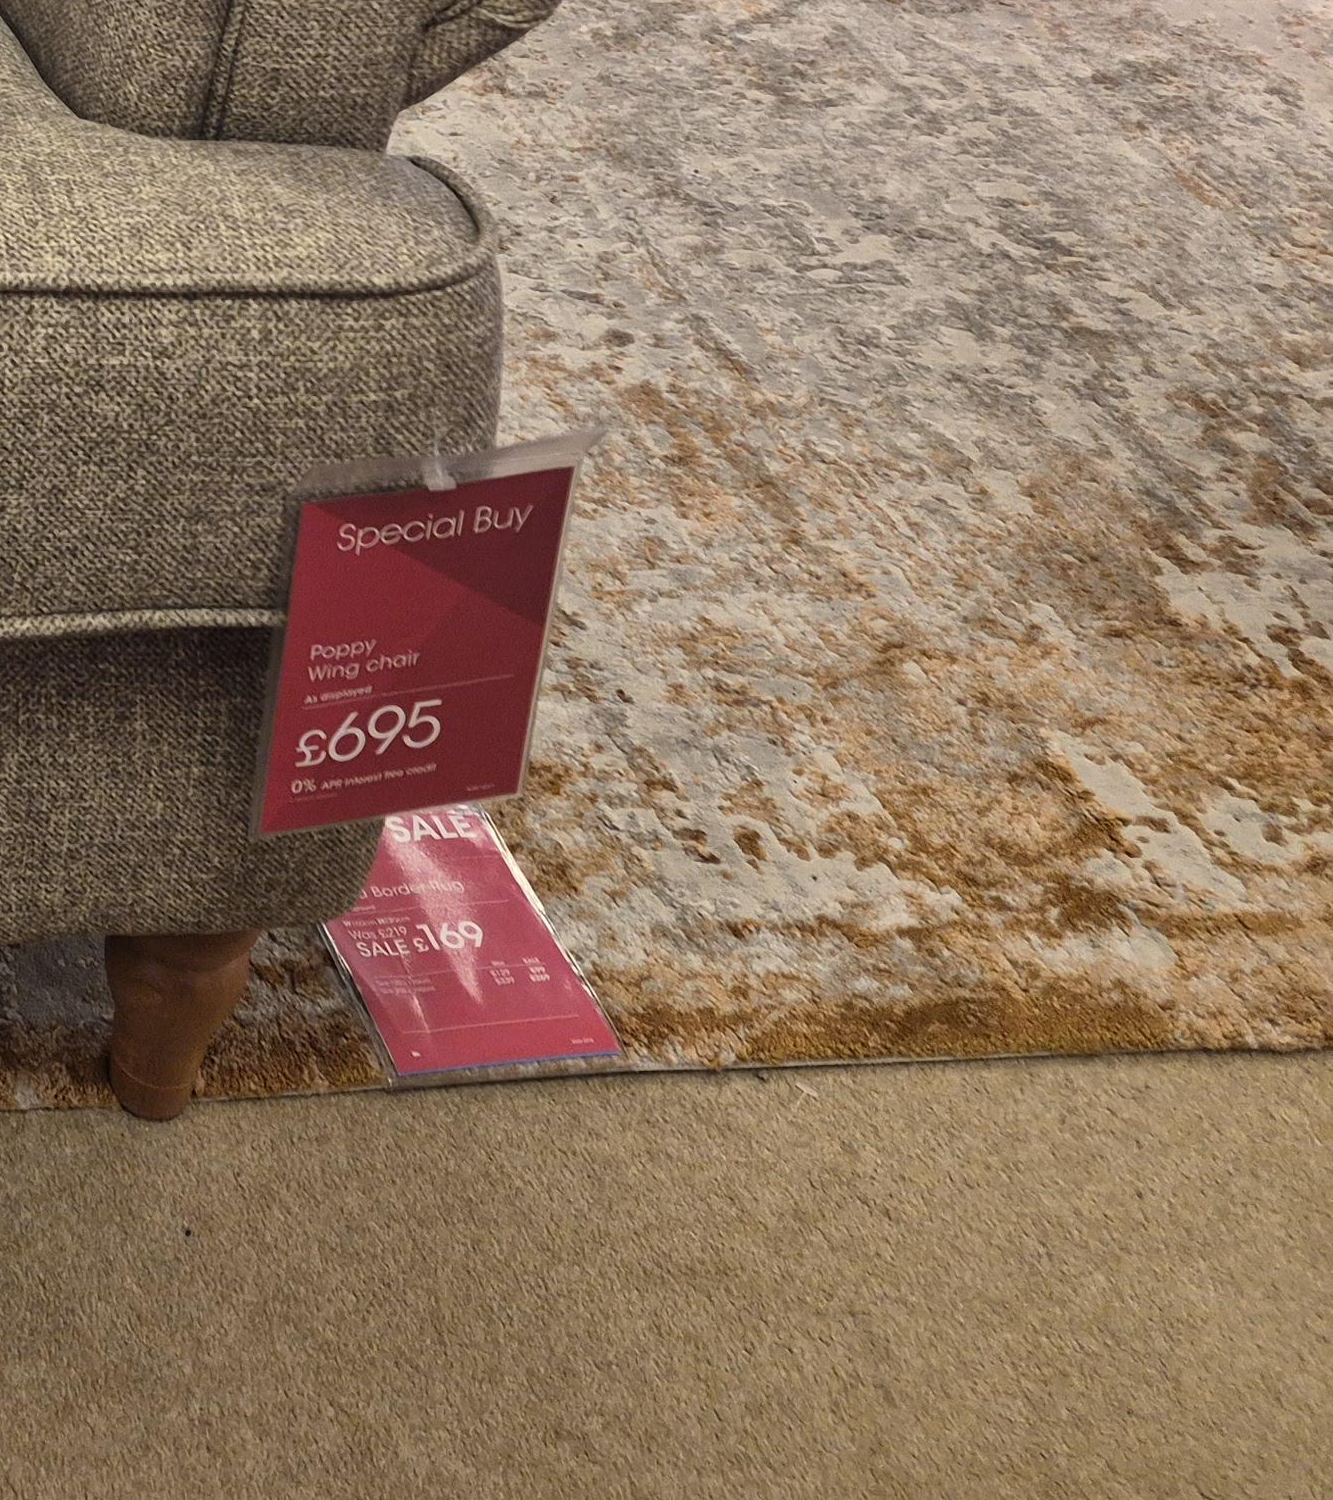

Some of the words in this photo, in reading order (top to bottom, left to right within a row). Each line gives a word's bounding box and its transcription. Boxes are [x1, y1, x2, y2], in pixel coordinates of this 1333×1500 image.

[336, 510, 464, 555] Special
[473, 504, 534, 534] Buy
[310, 638, 377, 660] Poppy
[307, 662, 360, 682] Wing
[366, 650, 420, 673] chair
[295, 699, 443, 768] £695
[290, 778, 317, 794] 0%
[384, 814, 477, 842] SALE
[348, 929, 377, 941] Was
[378, 925, 407, 940] £219
[356, 938, 411, 958] SALE
[413, 920, 483, 954] £169
